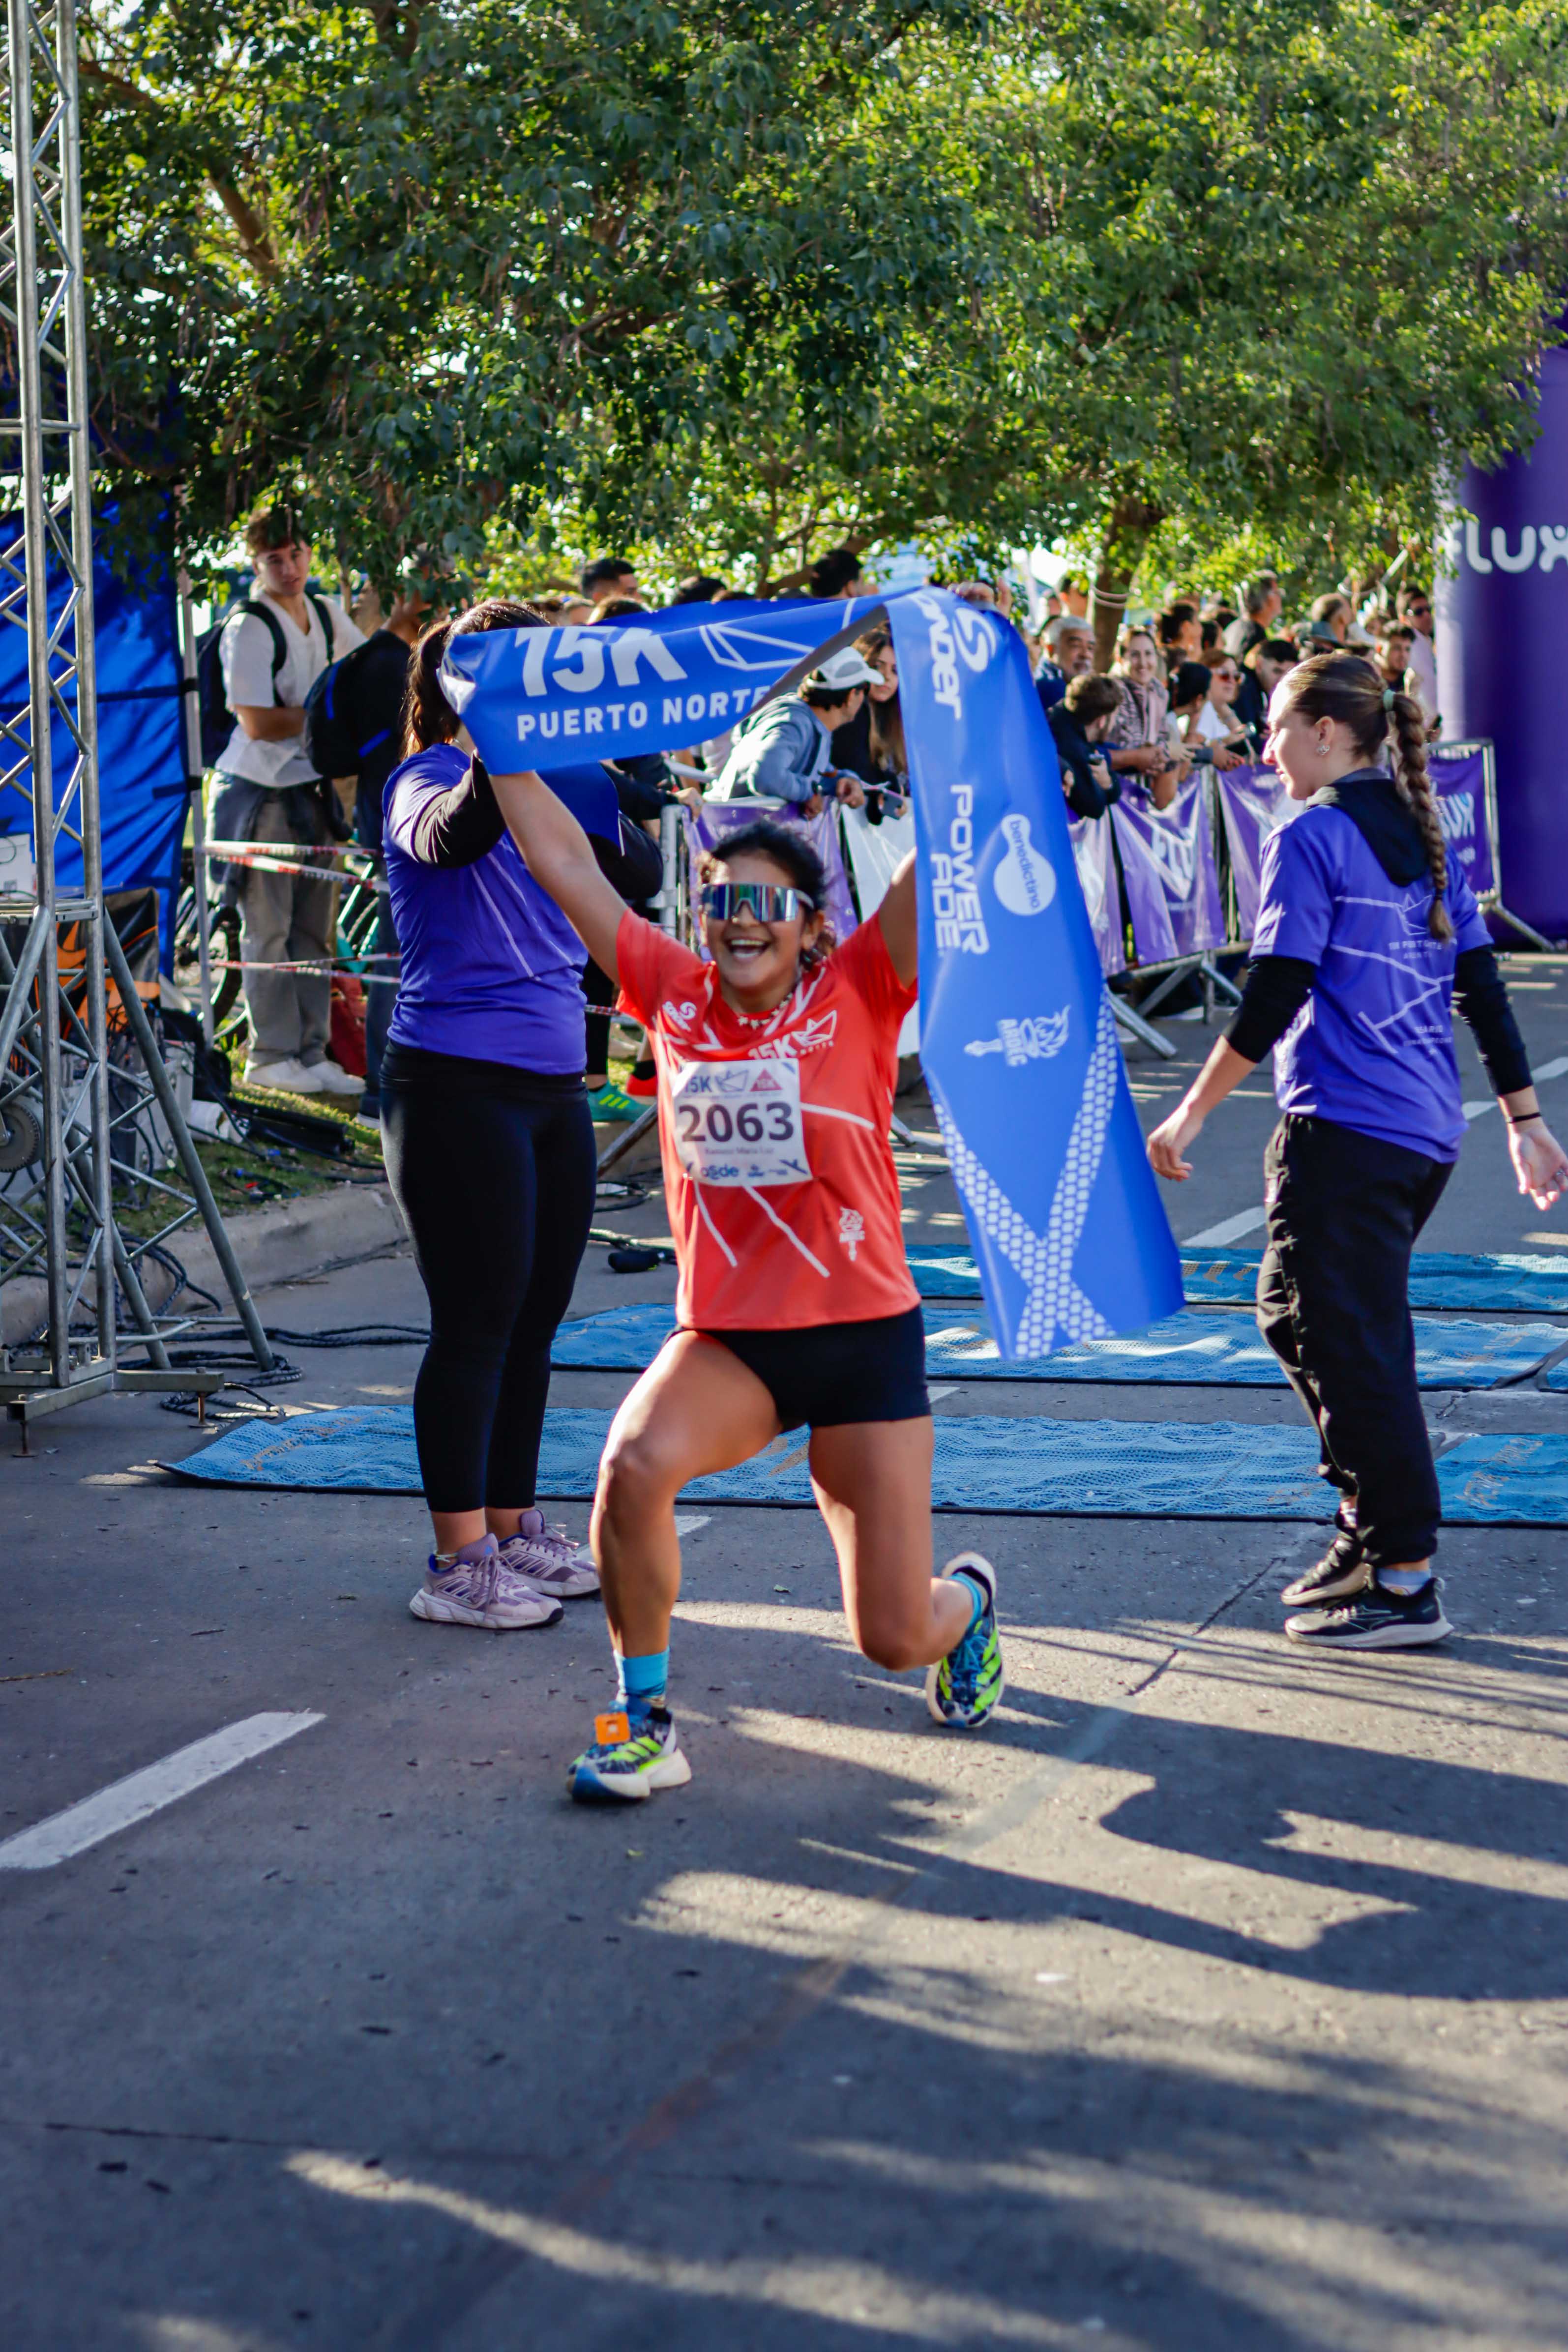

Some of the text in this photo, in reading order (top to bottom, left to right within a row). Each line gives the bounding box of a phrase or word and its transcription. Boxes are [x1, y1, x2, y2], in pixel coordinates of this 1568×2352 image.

[514, 626, 688, 697] 15K
[517, 702, 648, 741] PUERTO
[930, 853, 961, 949] ADE
[950, 784, 990, 955] POWER
[1009, 820, 1041, 909] benedictino
[679, 1101, 795, 1142] 2063
